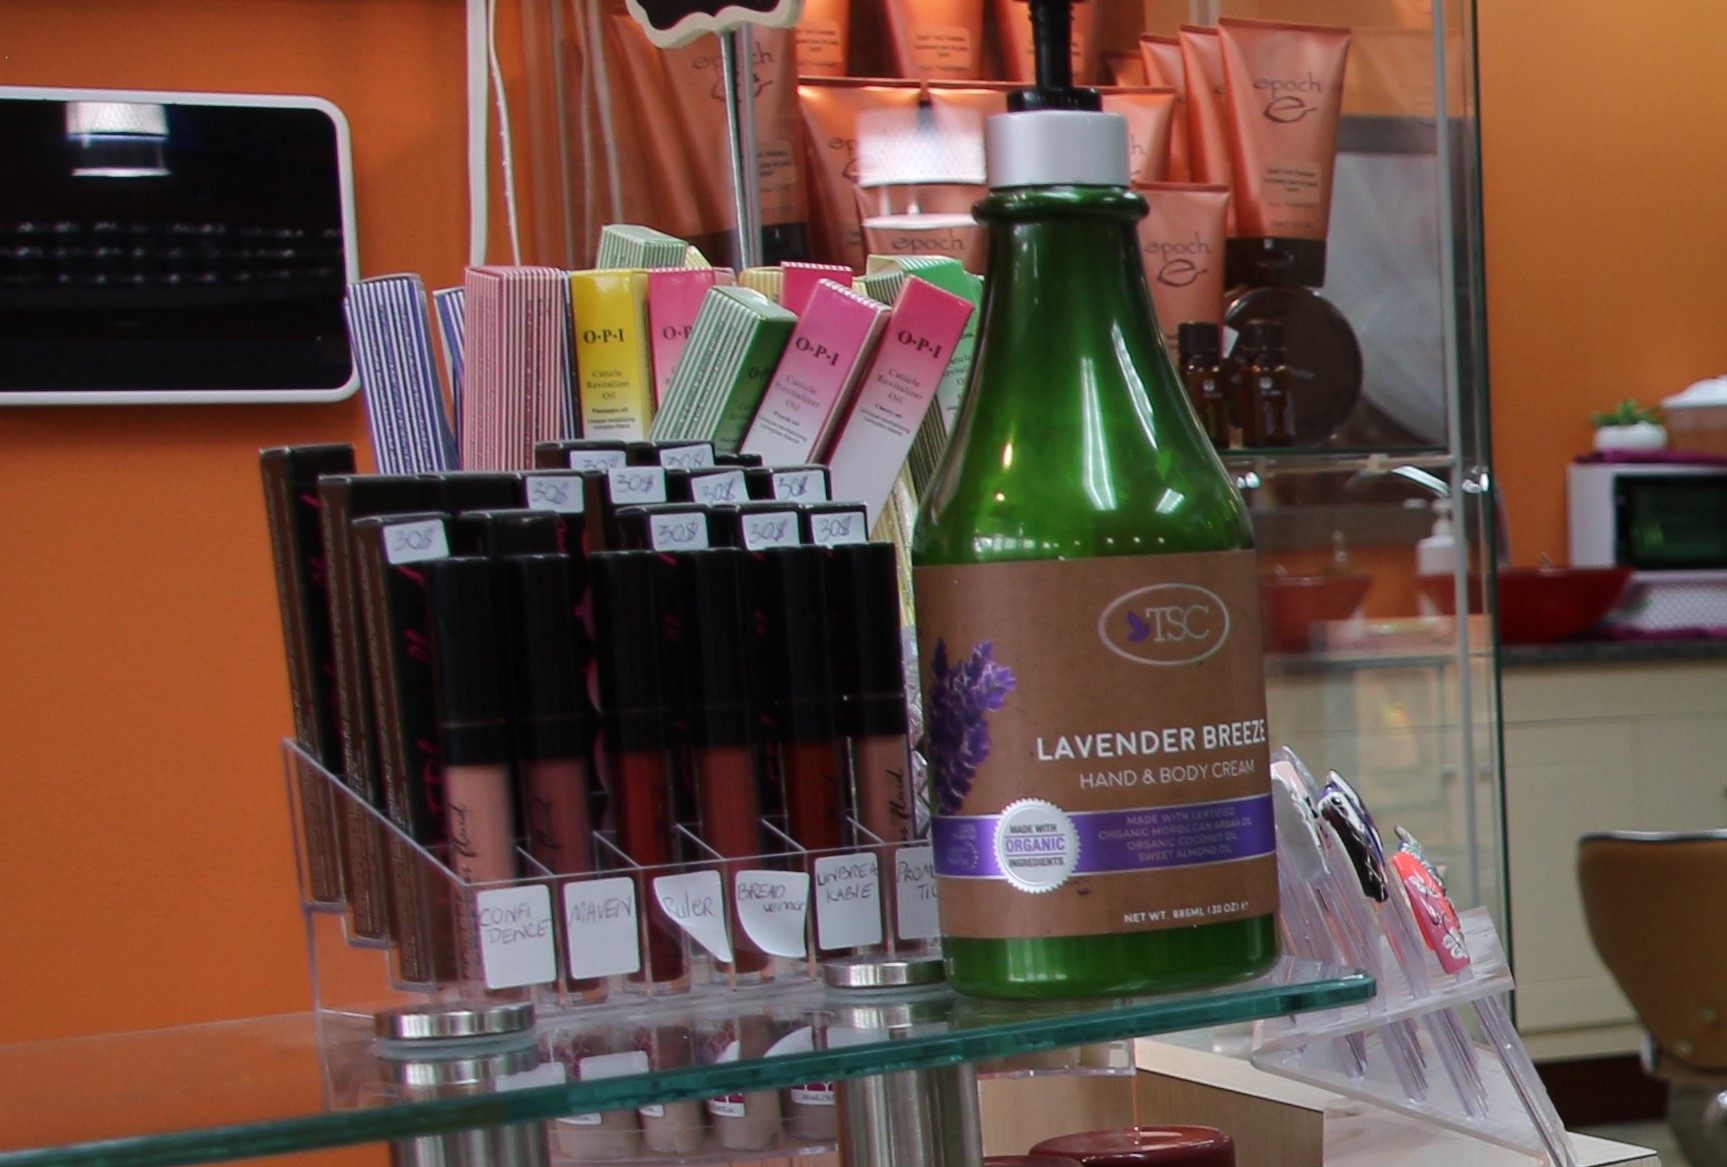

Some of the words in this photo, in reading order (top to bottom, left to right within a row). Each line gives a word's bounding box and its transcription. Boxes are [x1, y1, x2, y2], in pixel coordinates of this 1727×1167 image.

[1253, 72, 1322, 99] epoch
[891, 227, 965, 254] epoch
[1144, 233, 1213, 262] epoch
[1146, 605, 1210, 642] TSC
[1037, 726, 1196, 761] LAVENDER
[1202, 718, 1267, 749] BREEZE
[1080, 769, 1137, 789] HAND
[1142, 768, 1156, 784] &
[1160, 764, 1208, 783] BODY
[1212, 759, 1255, 778] CREAM
[1010, 824, 1034, 834] MADE
[1035, 823, 1057, 833] WITH
[1006, 836, 1065, 853] ORGANIC
[1009, 857, 1064, 867] INGREDIENTS
[1124, 911, 1146, 924] NET
